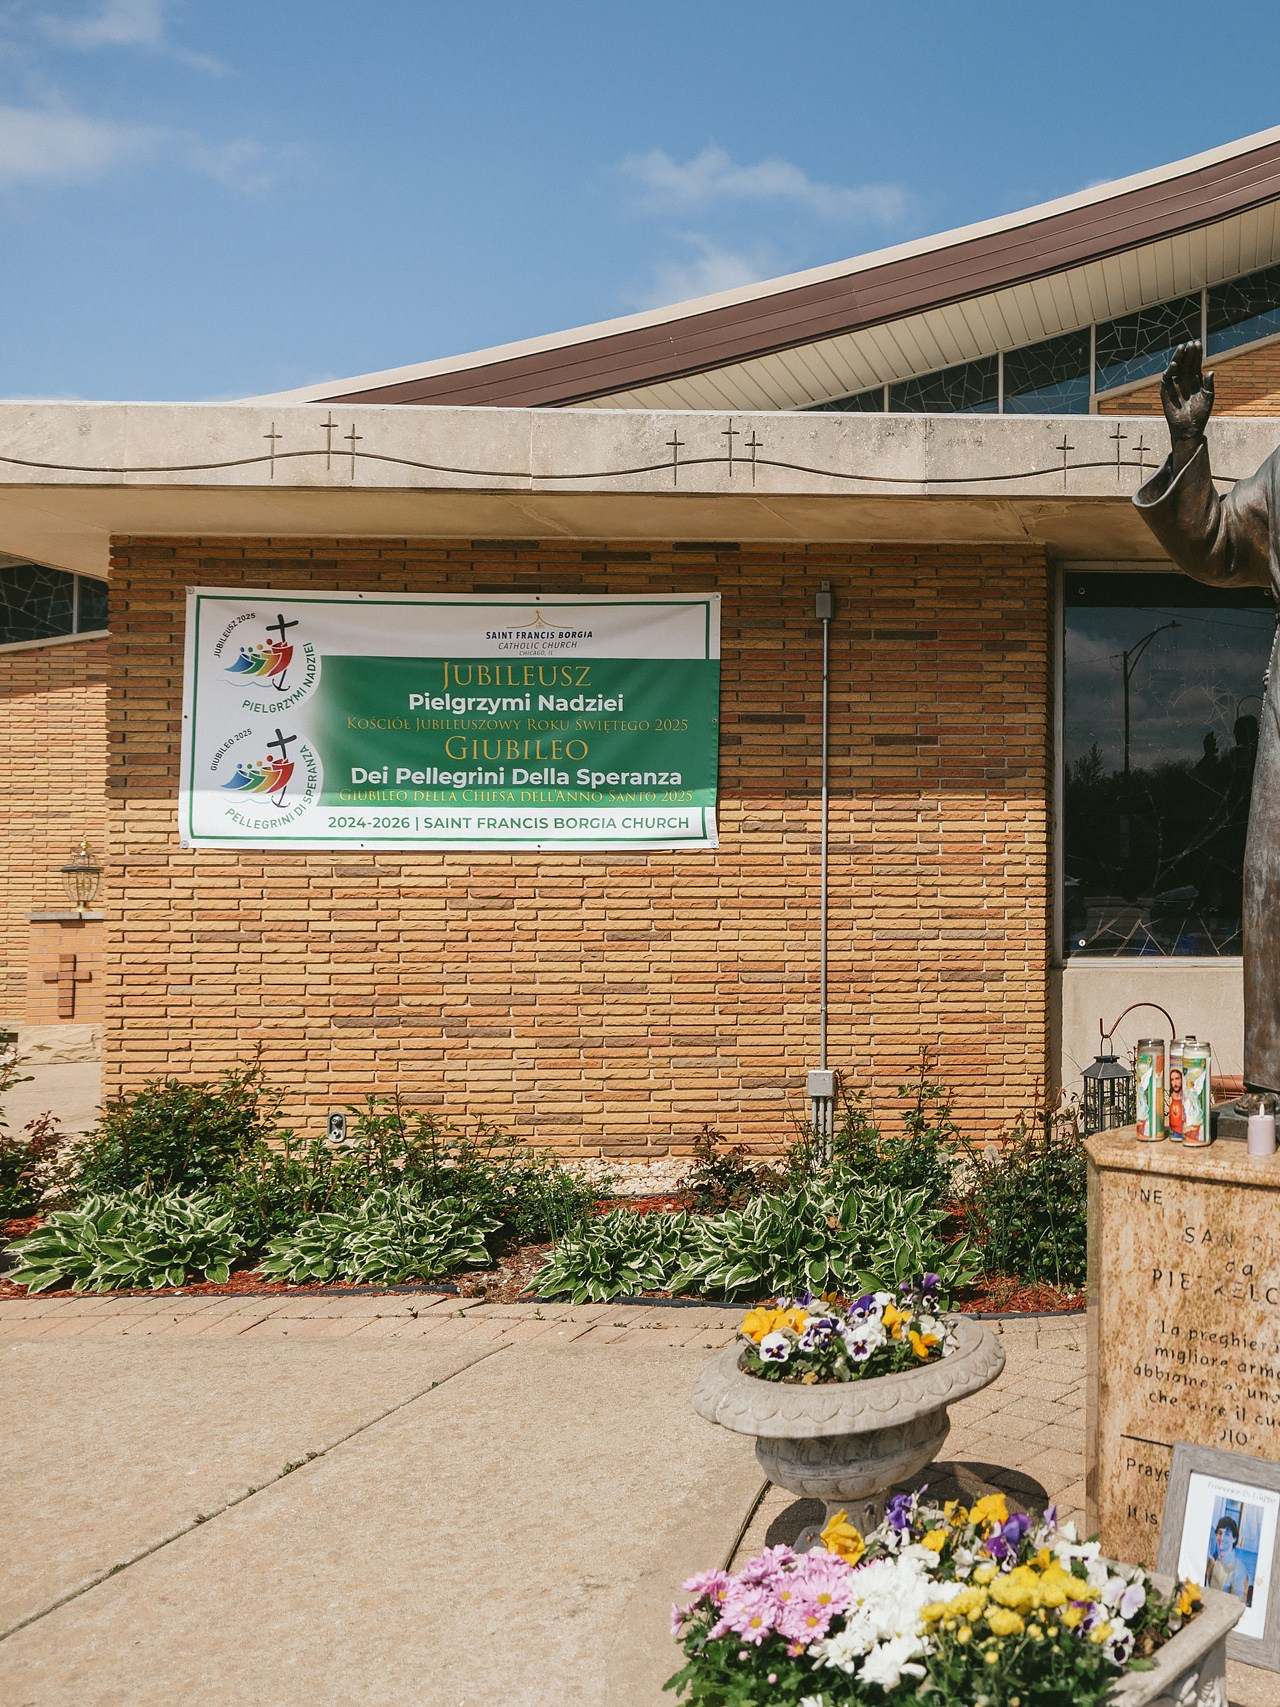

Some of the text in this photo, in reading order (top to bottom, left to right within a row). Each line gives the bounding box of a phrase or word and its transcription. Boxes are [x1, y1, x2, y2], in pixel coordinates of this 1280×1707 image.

[213, 612, 256, 658] JUBILEUSZ 2025
[486, 631, 593, 639] SAINT FRANCIS BORGIA
[498, 641, 578, 650] CATHOLIC CHURCH
[242, 642, 316, 713] PIELGRZYMI NADZIEI
[441, 661, 592, 692] JUBILEUSZ
[409, 692, 624, 715] Pielgrzymi Nadziei
[347, 716, 689, 734] KOŚCIÓŁ JUBILEUSZOWY ROKU ŚWIĘTEGO 2025
[210, 728, 253, 771] GIUBILEO 2025
[445, 735, 589, 761] GIUBILEO
[225, 745, 317, 829] PELLEGRINI DI SPERANZA
[351, 766, 682, 789] Dei Pellegrini Della Speranza
[339, 789, 693, 802] GIUBILEO DELLA CHIESA DELL'ANNO SANTO 2025
[328, 816, 410, 829] 2024-2026
[424, 817, 472, 829] SAINT
[477, 817, 548, 829] FRANCIS
[554, 817, 617, 829] BORGIA
[621, 817, 689, 829] CHURCH
[1185, 1227, 1234, 1248] SAN
[1155, 1347, 1228, 1369] migliore
[1149, 1390, 1178, 1406] che
[1236, 1405, 1246, 1422] il
[1126, 1457, 1170, 1481] Praye
[1128, 1504, 1137, 1521] It
[1145, 1509, 1158, 1525] is
